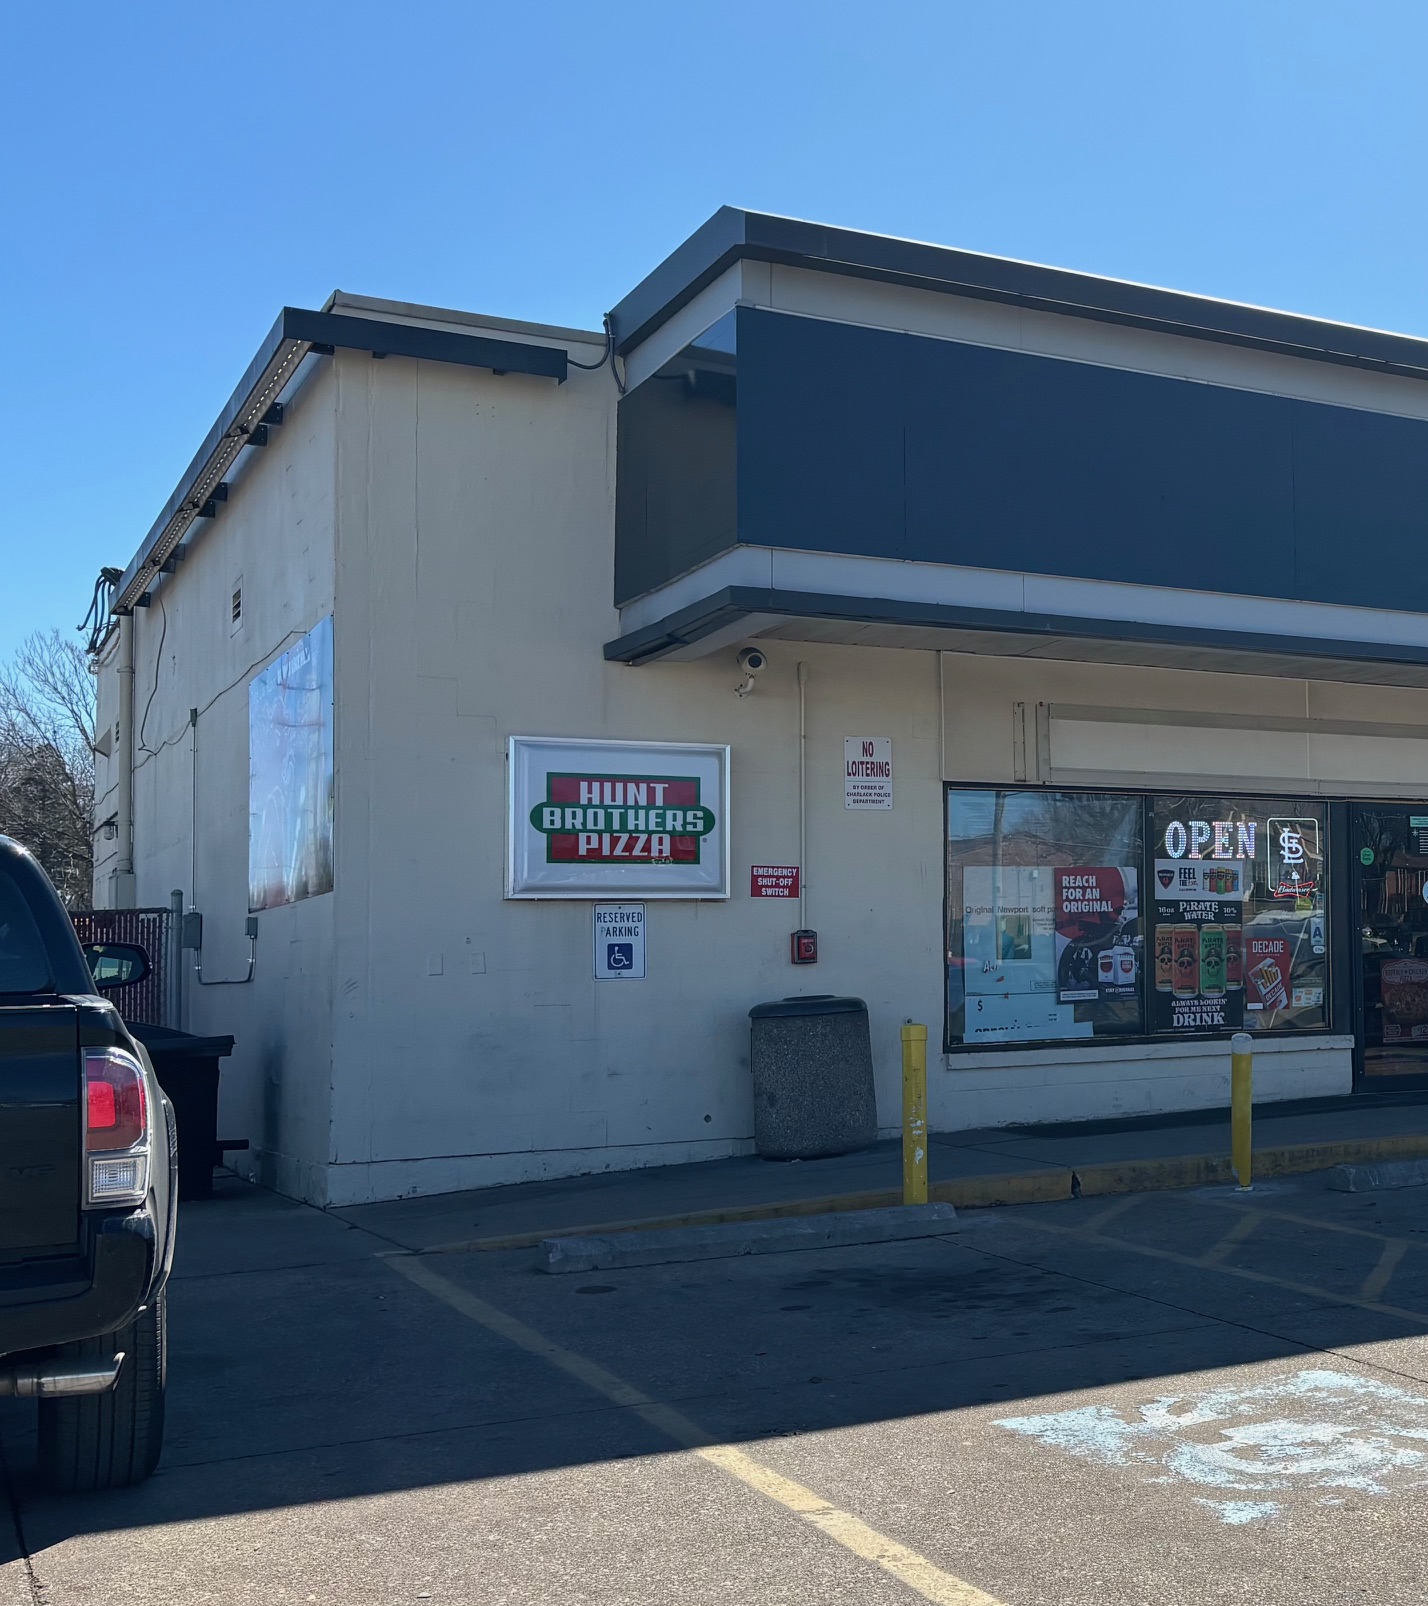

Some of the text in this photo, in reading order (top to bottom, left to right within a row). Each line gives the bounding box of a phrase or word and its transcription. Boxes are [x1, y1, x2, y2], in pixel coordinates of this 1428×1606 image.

[862, 741, 874, 758] NO
[846, 760, 891, 778] LOITERING
[580, 781, 669, 806] HUNT
[542, 807, 704, 832] BROTHERS
[578, 833, 671, 857] PIZZA
[1165, 821, 1257, 859] OPEN
[753, 867, 797, 876] EMERGENCY
[1178, 867, 1197, 880] FEEL
[757, 877, 793, 886] SHUT-OFF
[1062, 876, 1096, 887] REACH
[761, 887, 789, 896] SWITCH
[1062, 888, 1100, 900] FOR AN
[965, 905, 994, 916] Original
[997, 905, 1029, 916] Newport
[1032, 905, 1047, 914] soft
[1062, 901, 1114, 913] ORIGINAL
[597, 912, 643, 924] RESERVED
[1184, 911, 1215, 921] WATER
[600, 926, 639, 938] PARKING
[1312, 926, 1323, 938] A
[1252, 941, 1284, 953] DECADE
[1265, 981, 1284, 1001] DECADE
[1171, 999, 1199, 1007] ALWAYS
[1172, 1012, 1226, 1027] DRINK
